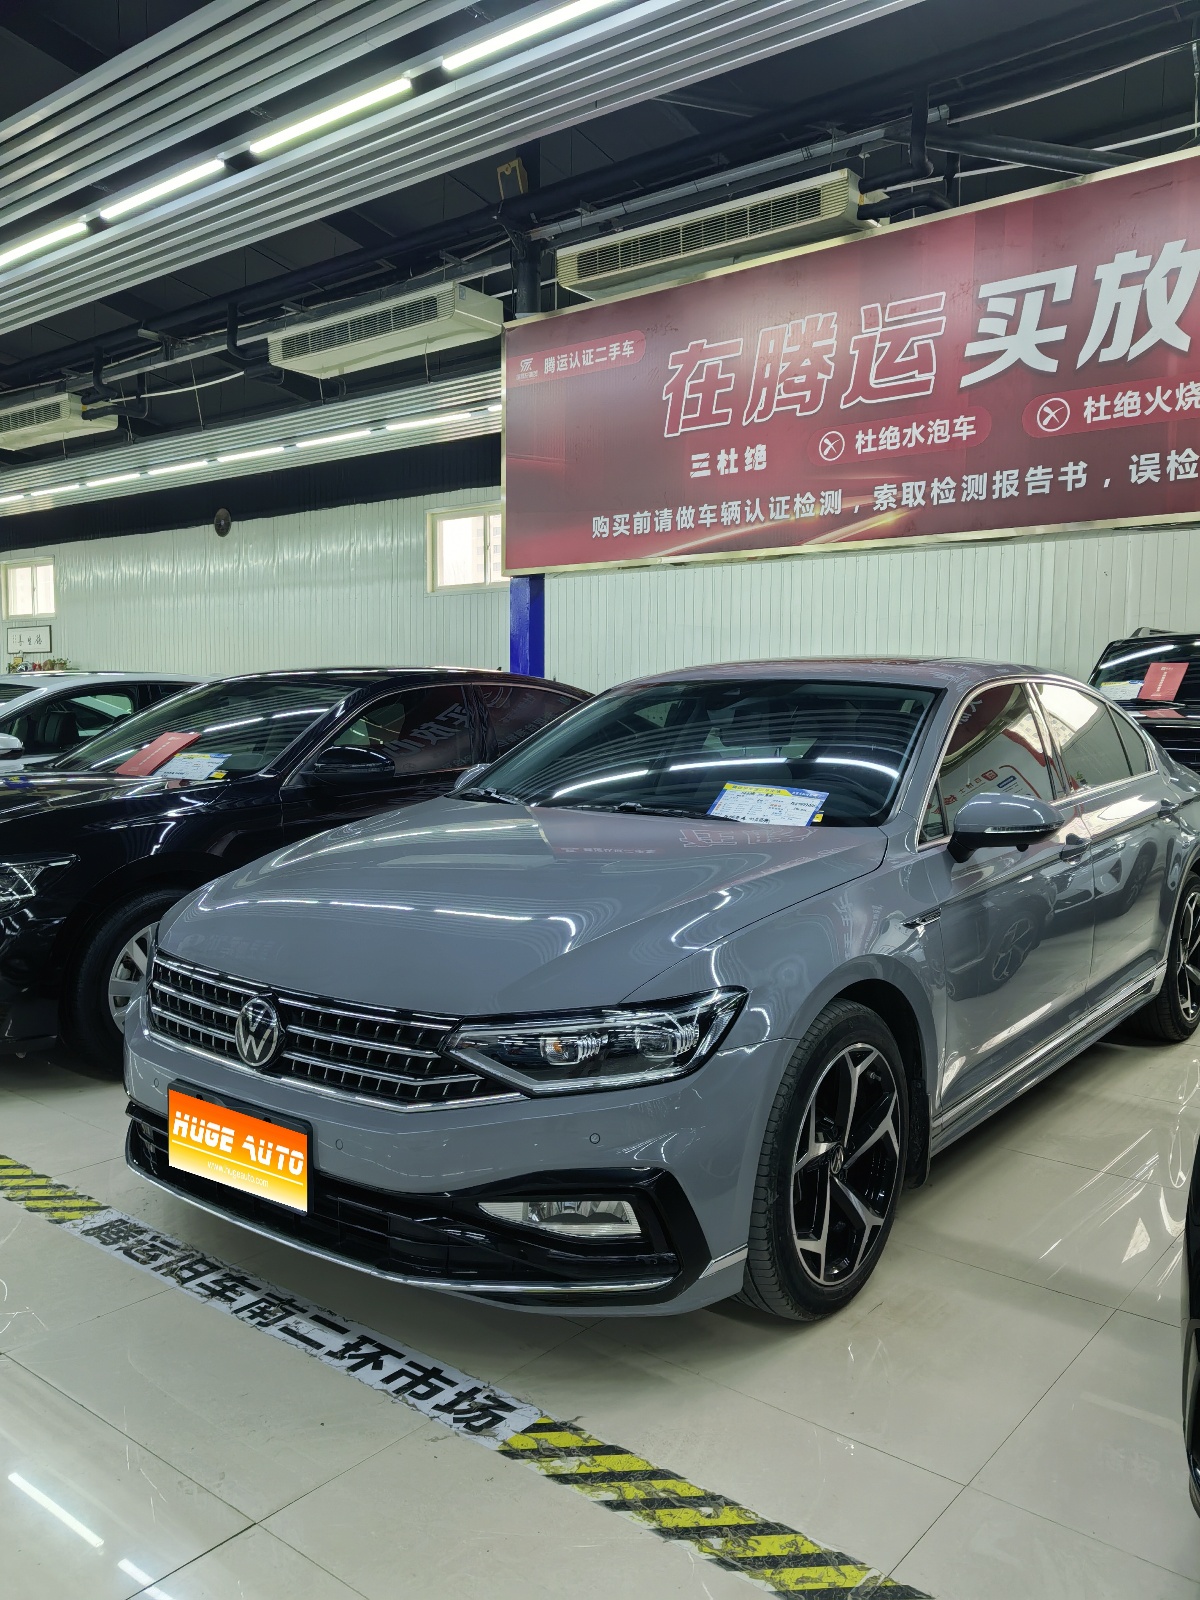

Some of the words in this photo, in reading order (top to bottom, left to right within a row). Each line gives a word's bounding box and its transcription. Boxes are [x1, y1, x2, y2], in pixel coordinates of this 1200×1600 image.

[544, 339, 635, 375] 腾运认证二手车
[854, 415, 977, 455] 杜绝水泡车
[690, 444, 768, 479] 三杜绝
